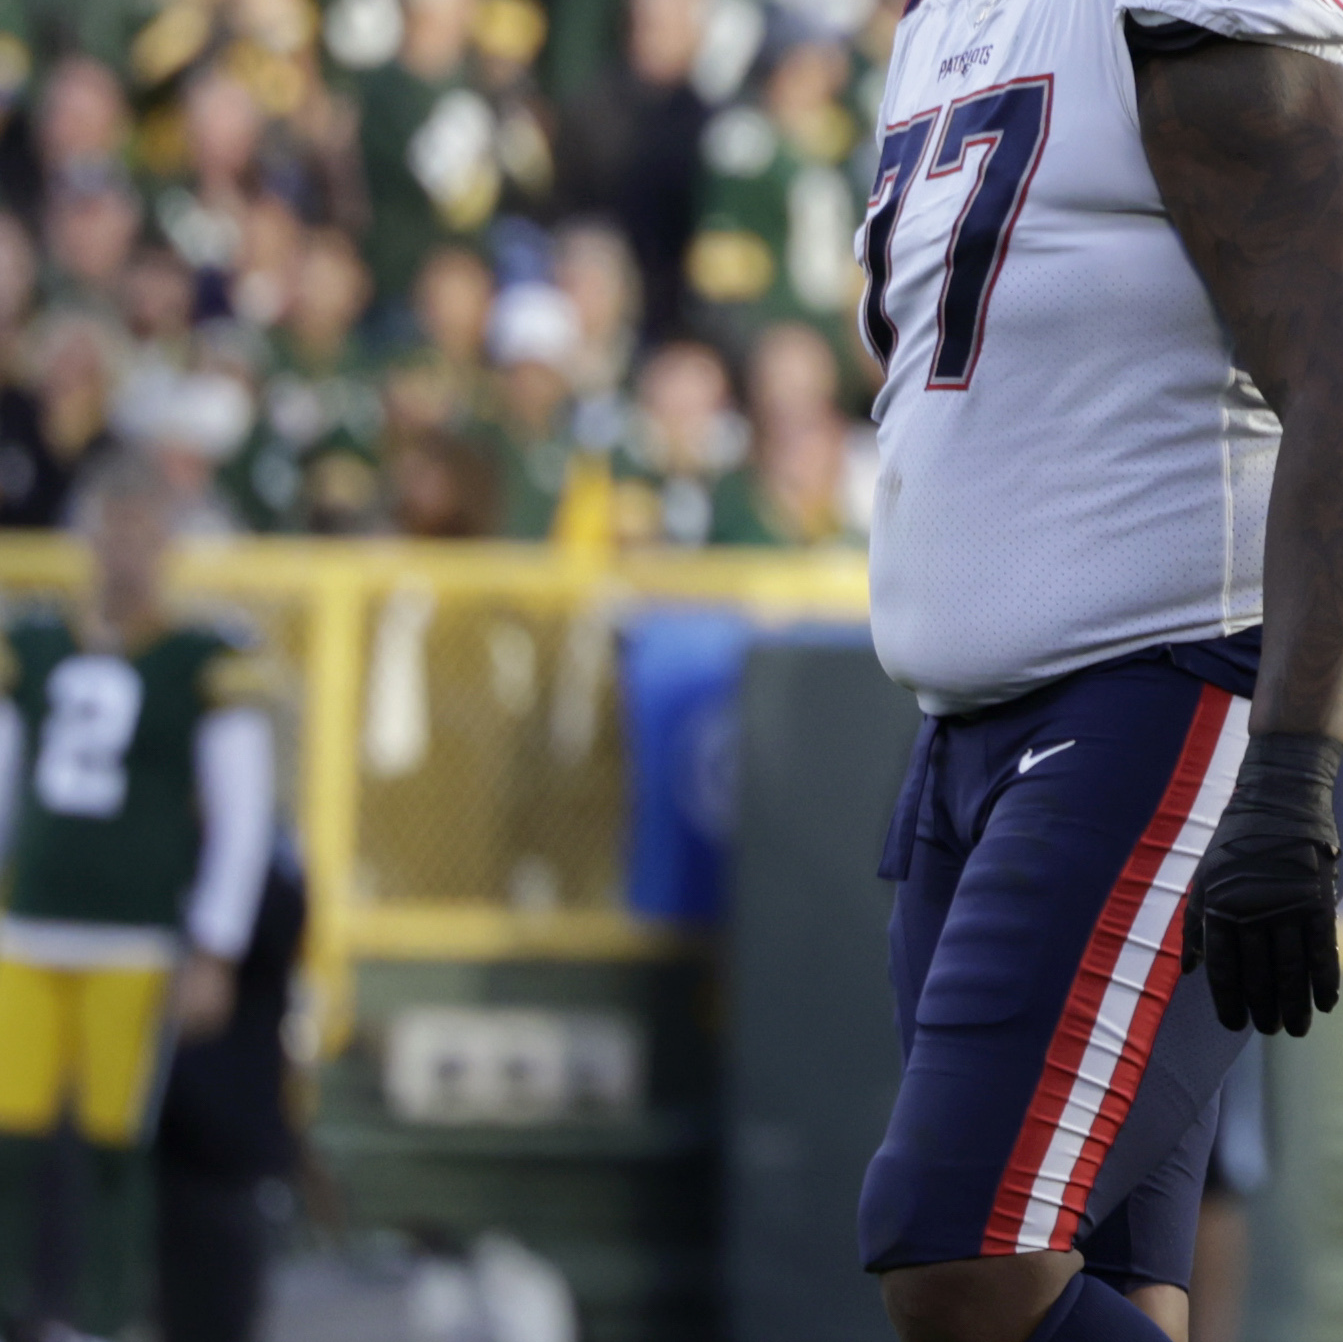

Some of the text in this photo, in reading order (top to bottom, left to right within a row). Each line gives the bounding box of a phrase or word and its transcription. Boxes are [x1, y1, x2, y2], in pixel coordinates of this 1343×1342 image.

[937, 44, 994, 83] PATRIOTS
[863, 72, 1054, 391] 77
[37, 655, 145, 814] 2
